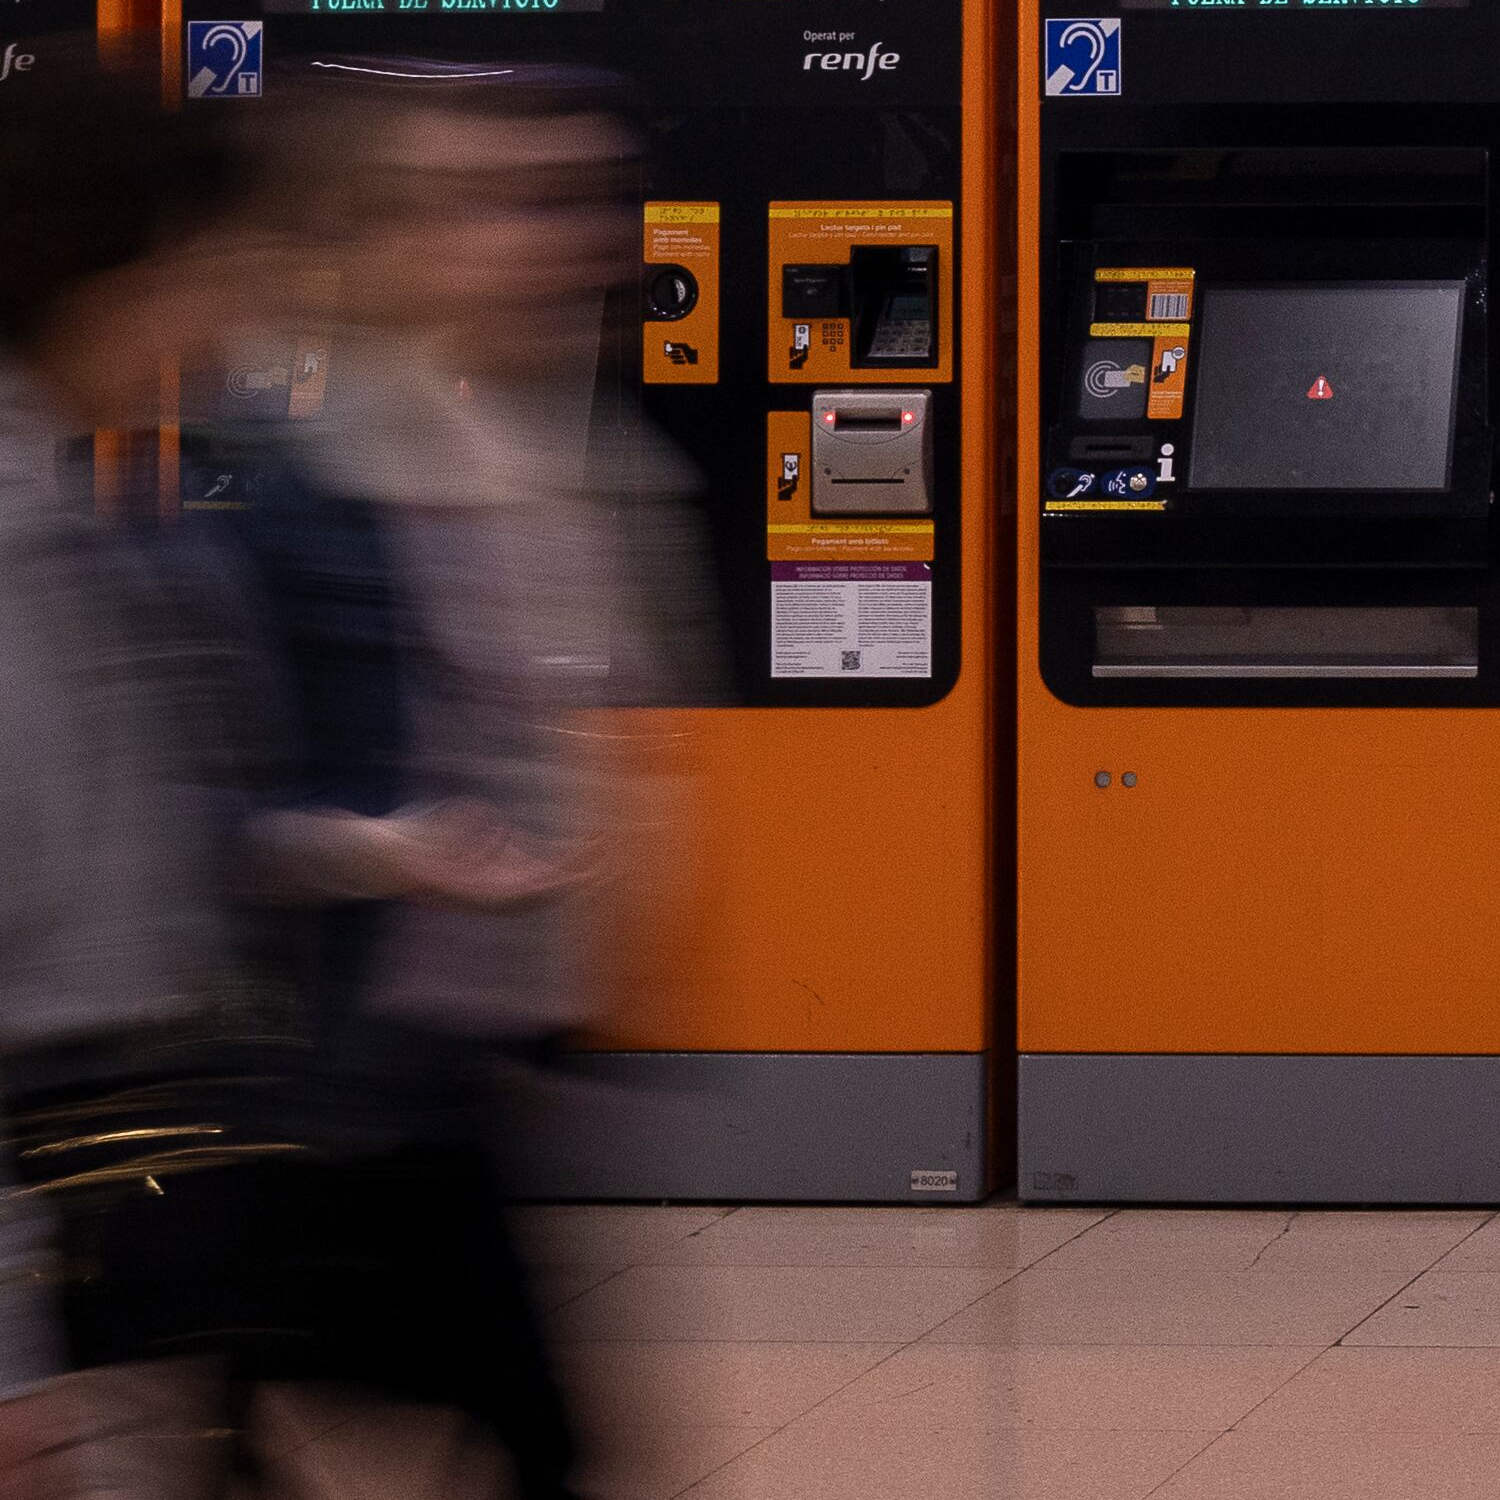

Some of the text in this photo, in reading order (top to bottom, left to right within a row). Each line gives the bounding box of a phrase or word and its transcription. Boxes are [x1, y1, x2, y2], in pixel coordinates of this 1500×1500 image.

[803, 30, 854, 44] Operat per
[803, 42, 899, 80] renfe
[921, 1177, 947, 1186] 8020
